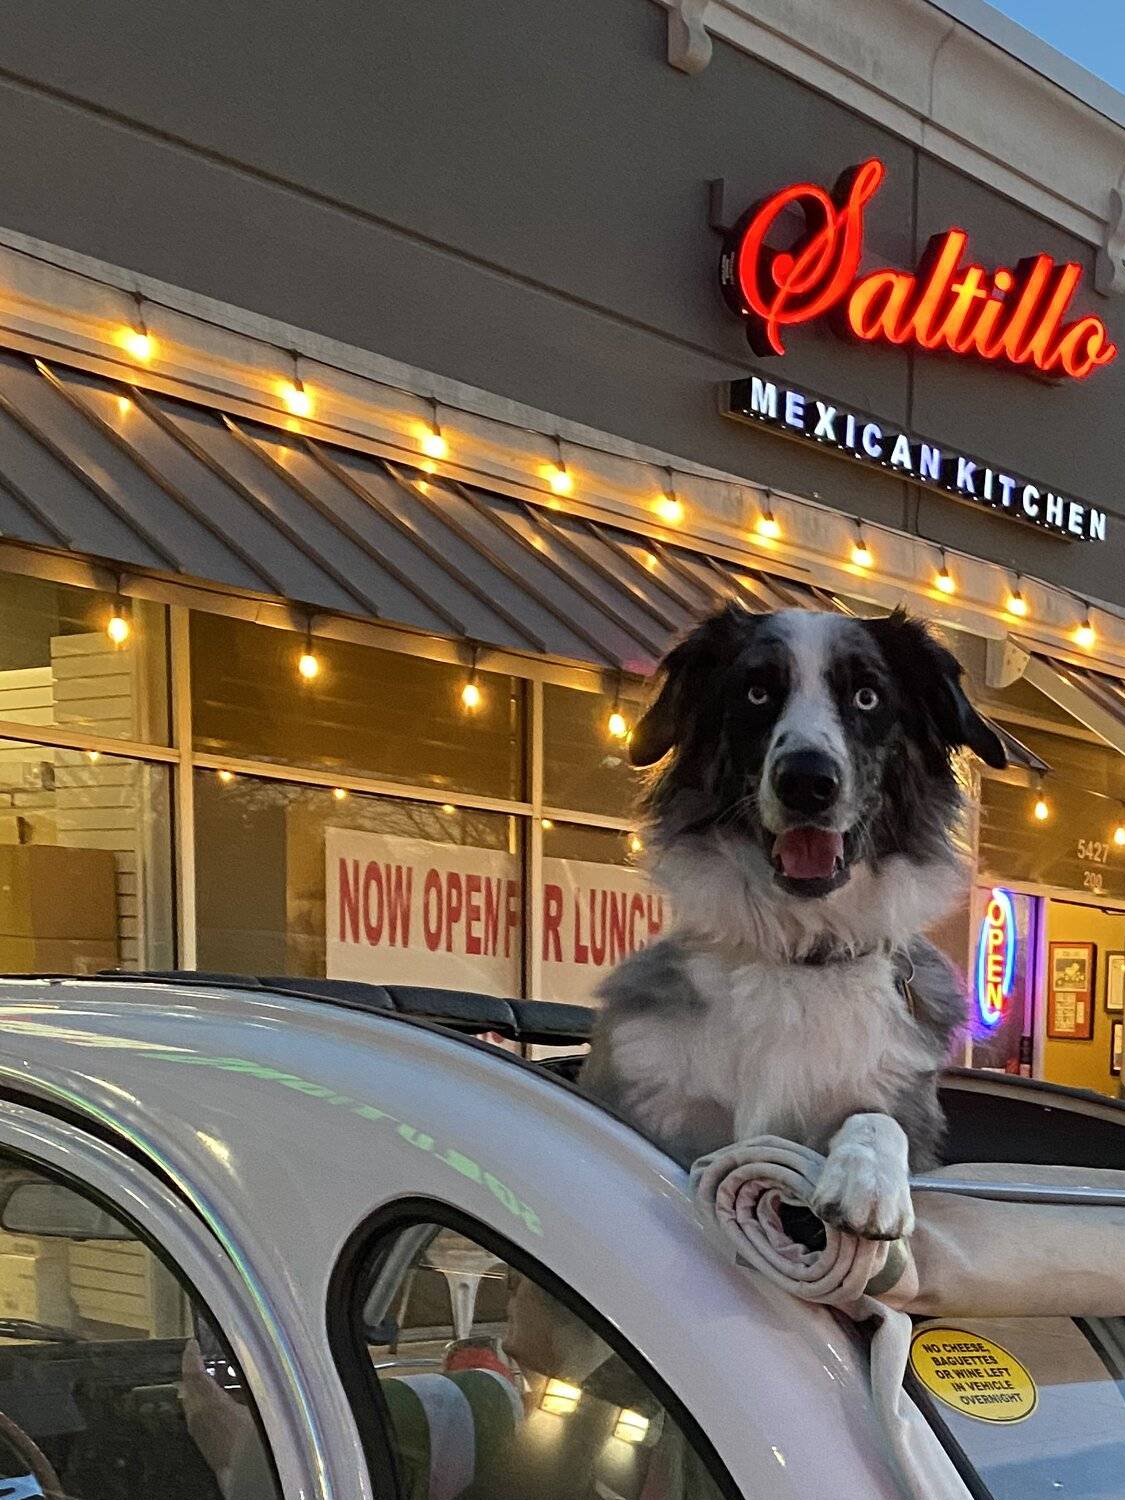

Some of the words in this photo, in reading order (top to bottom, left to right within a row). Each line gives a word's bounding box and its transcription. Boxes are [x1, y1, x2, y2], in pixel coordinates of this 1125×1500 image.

[739, 157, 1118, 379] Saltillo
[751, 376, 942, 480] MEXICAN
[957, 456, 1107, 541] KITCHEN
[1077, 839, 1109, 863] 5427
[339, 857, 413, 948] NOW
[423, 867, 500, 957] OPEN
[504, 879, 564, 963] FR
[987, 898, 1005, 1011] OPEN
[922, 1343, 941, 1353] NO
[930, 1355, 998, 1366] BAGUETTES
[935, 1369, 954, 1379] OR
[955, 1368, 984, 1379] WINE
[984, 1367, 1012, 1377] LEFT
[952, 1382, 965, 1392] IN
[966, 1380, 1014, 1391] VEHICLE
[960, 1393, 1023, 1406] OVERNIGHT
